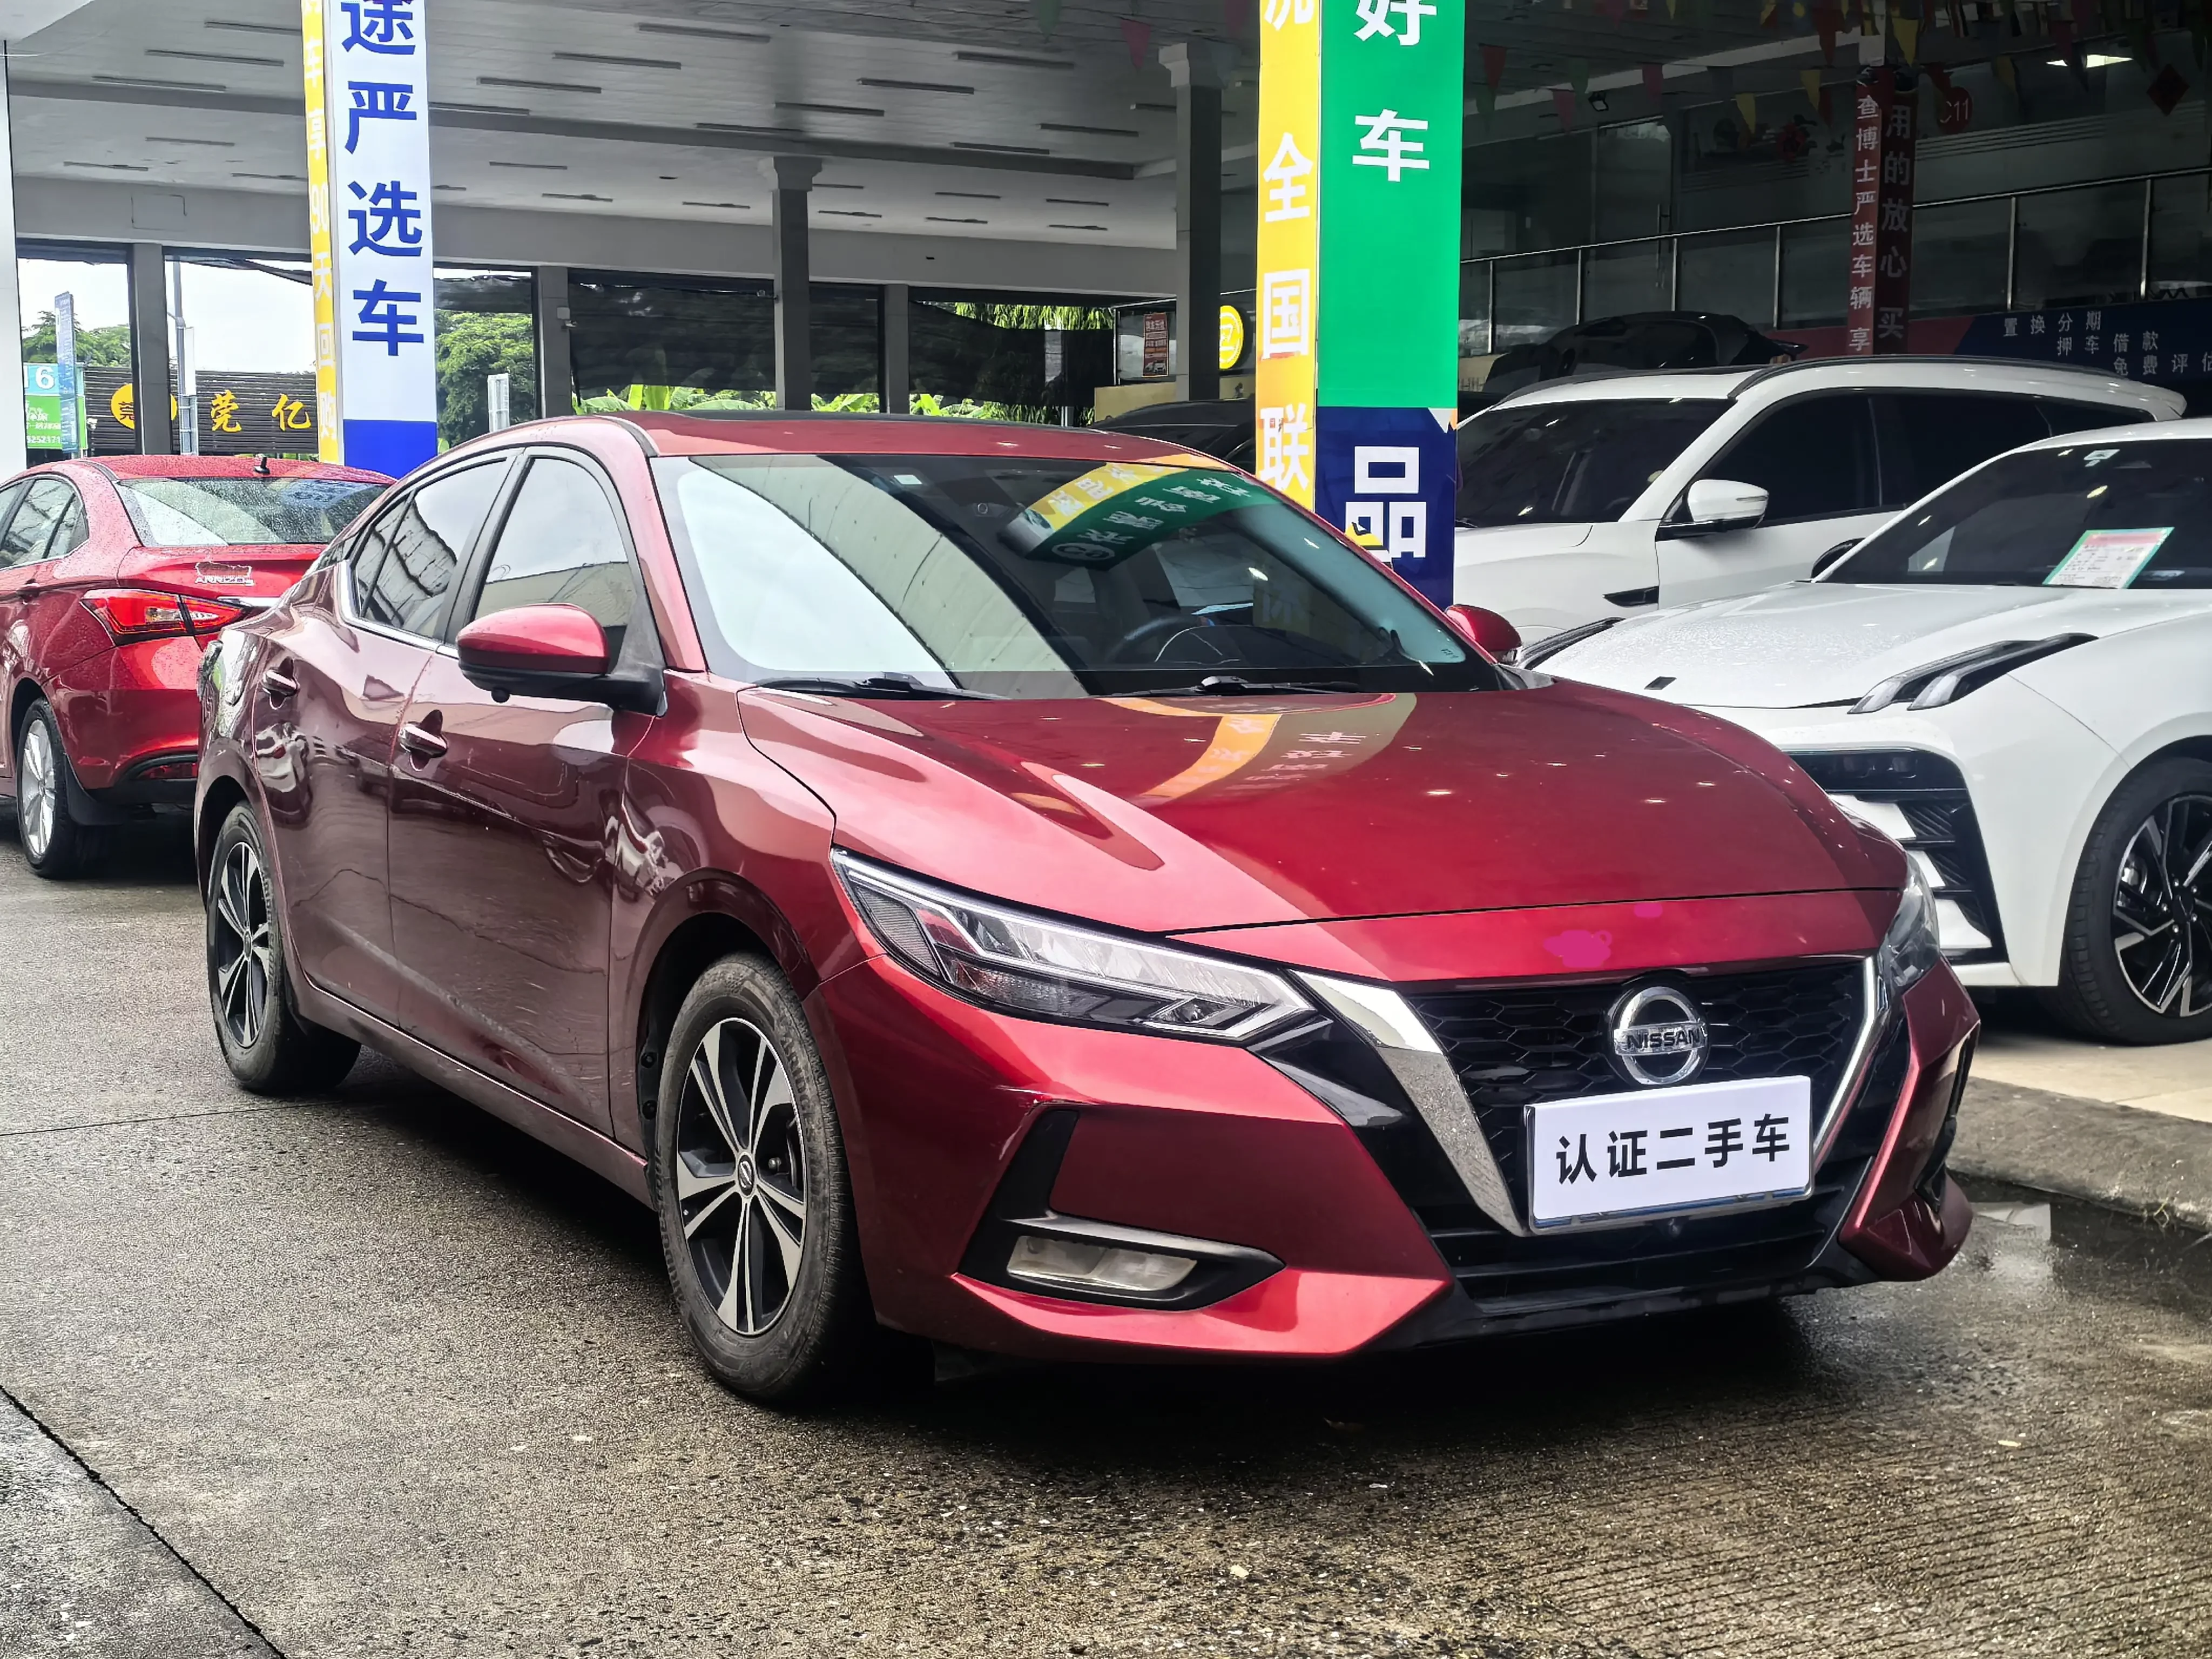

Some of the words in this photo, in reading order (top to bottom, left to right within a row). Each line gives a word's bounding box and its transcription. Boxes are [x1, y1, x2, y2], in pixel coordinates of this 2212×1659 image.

[1352, 0, 1437, 183] 好车
[341, 0, 424, 356] 途严选车
[1626, 1027, 1701, 1051] NISSAN
[1555, 1113, 1790, 1185] 认证二手车
